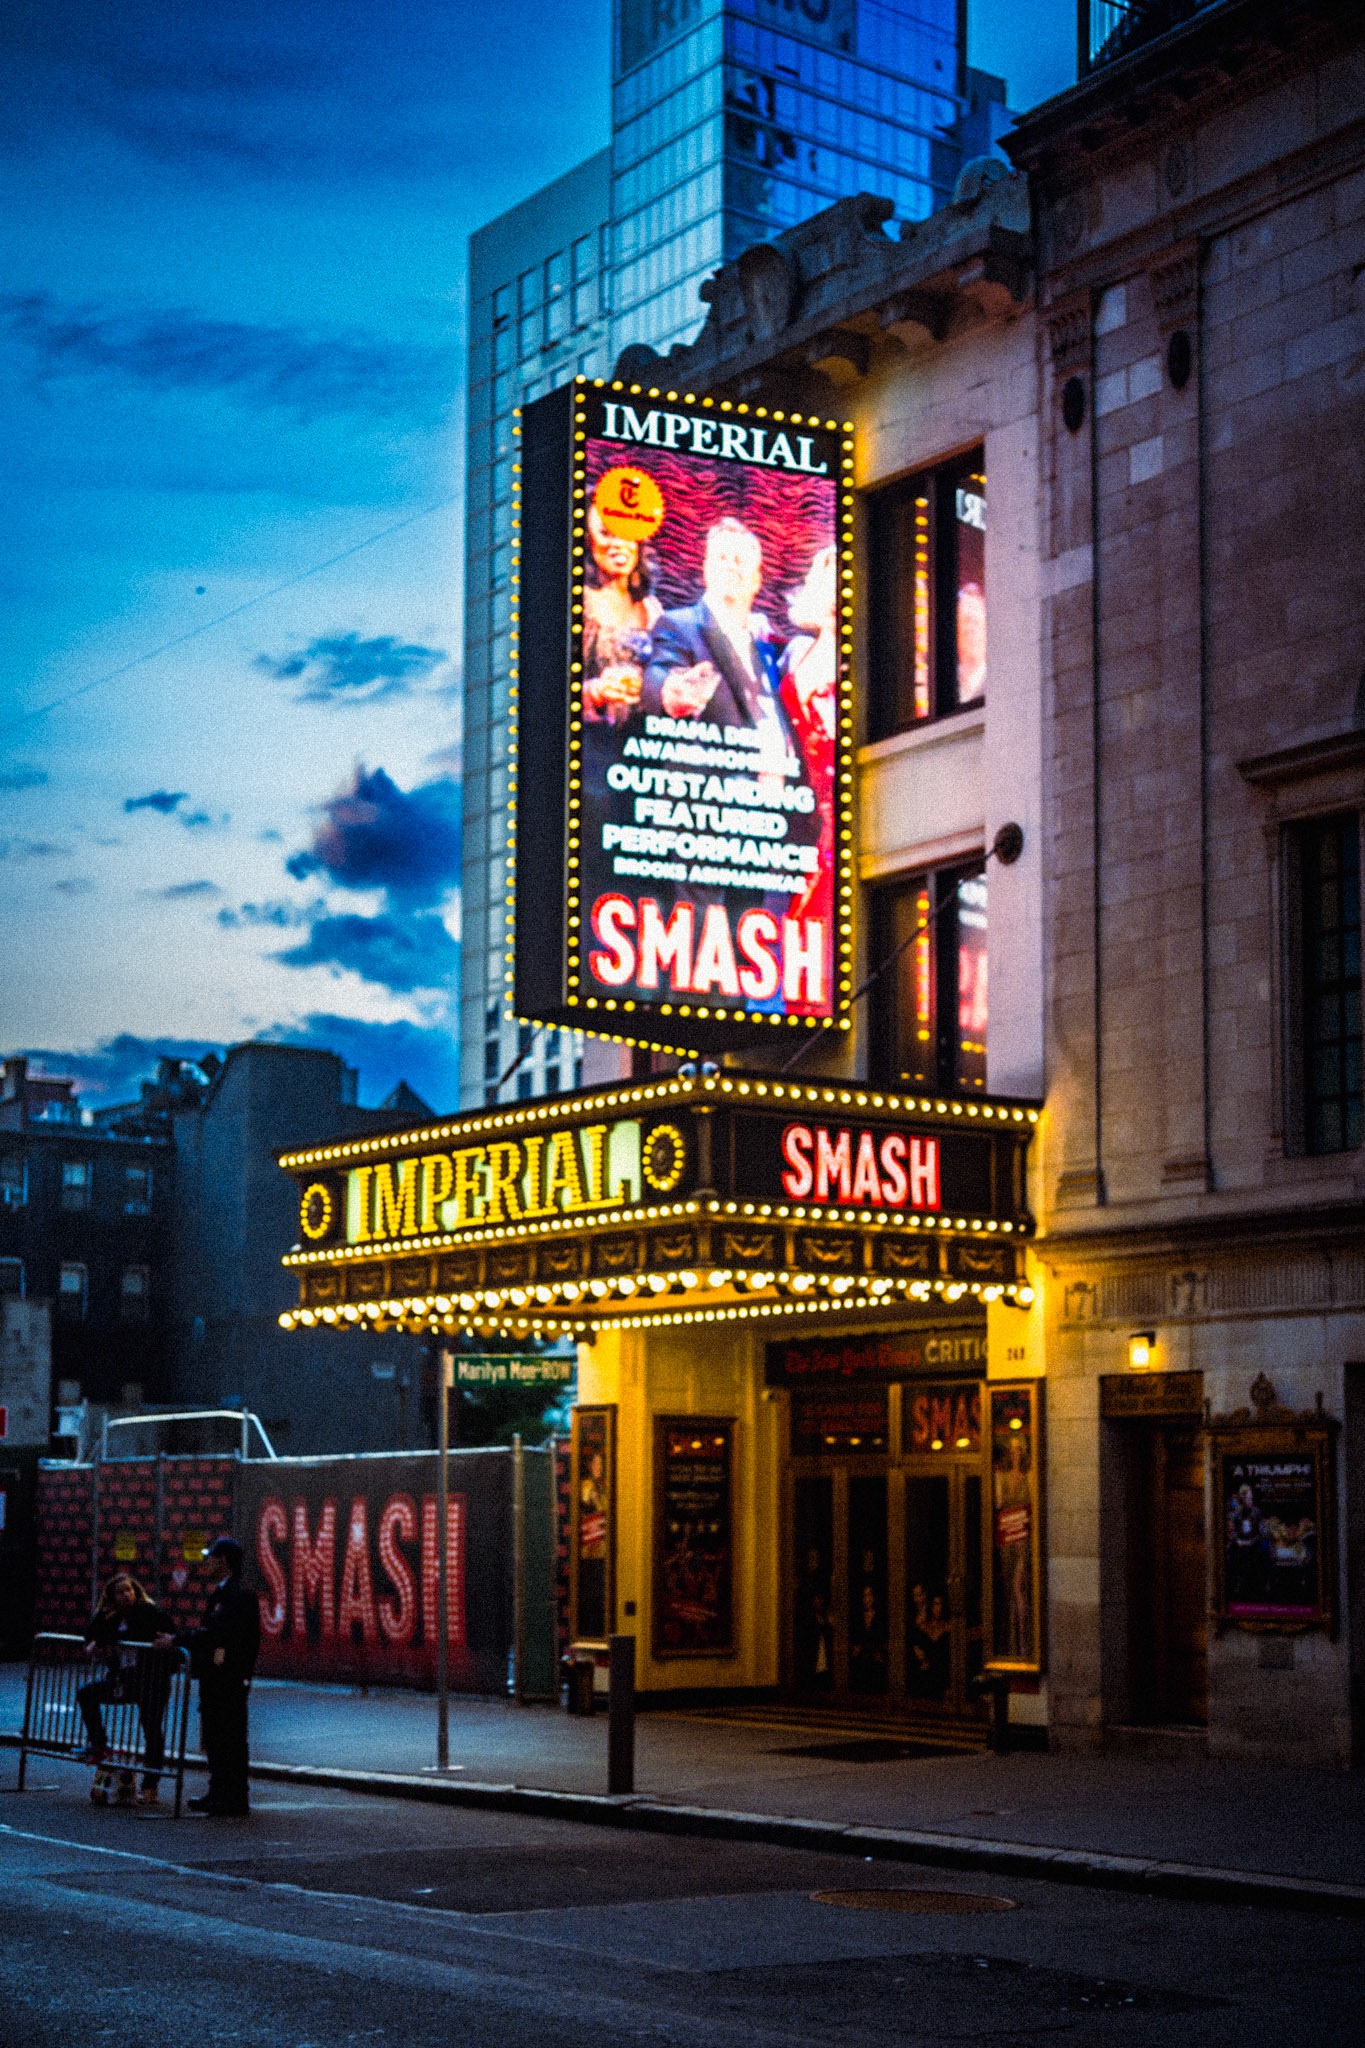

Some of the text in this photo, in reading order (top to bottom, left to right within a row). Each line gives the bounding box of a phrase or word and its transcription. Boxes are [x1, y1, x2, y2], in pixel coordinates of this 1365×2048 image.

[602, 402, 828, 474] IMPERIAL
[606, 764, 816, 814] OUTSTANDING
[635, 797, 788, 839] FEATURED
[602, 823, 820, 873] PERFORMANCE
[589, 892, 826, 1003] SMASH
[355, 1124, 625, 1243] IMPERIAL
[781, 1122, 942, 1211] SMASH
[912, 1395, 981, 1446] SMAS
[259, 1492, 467, 1648] SMASH
